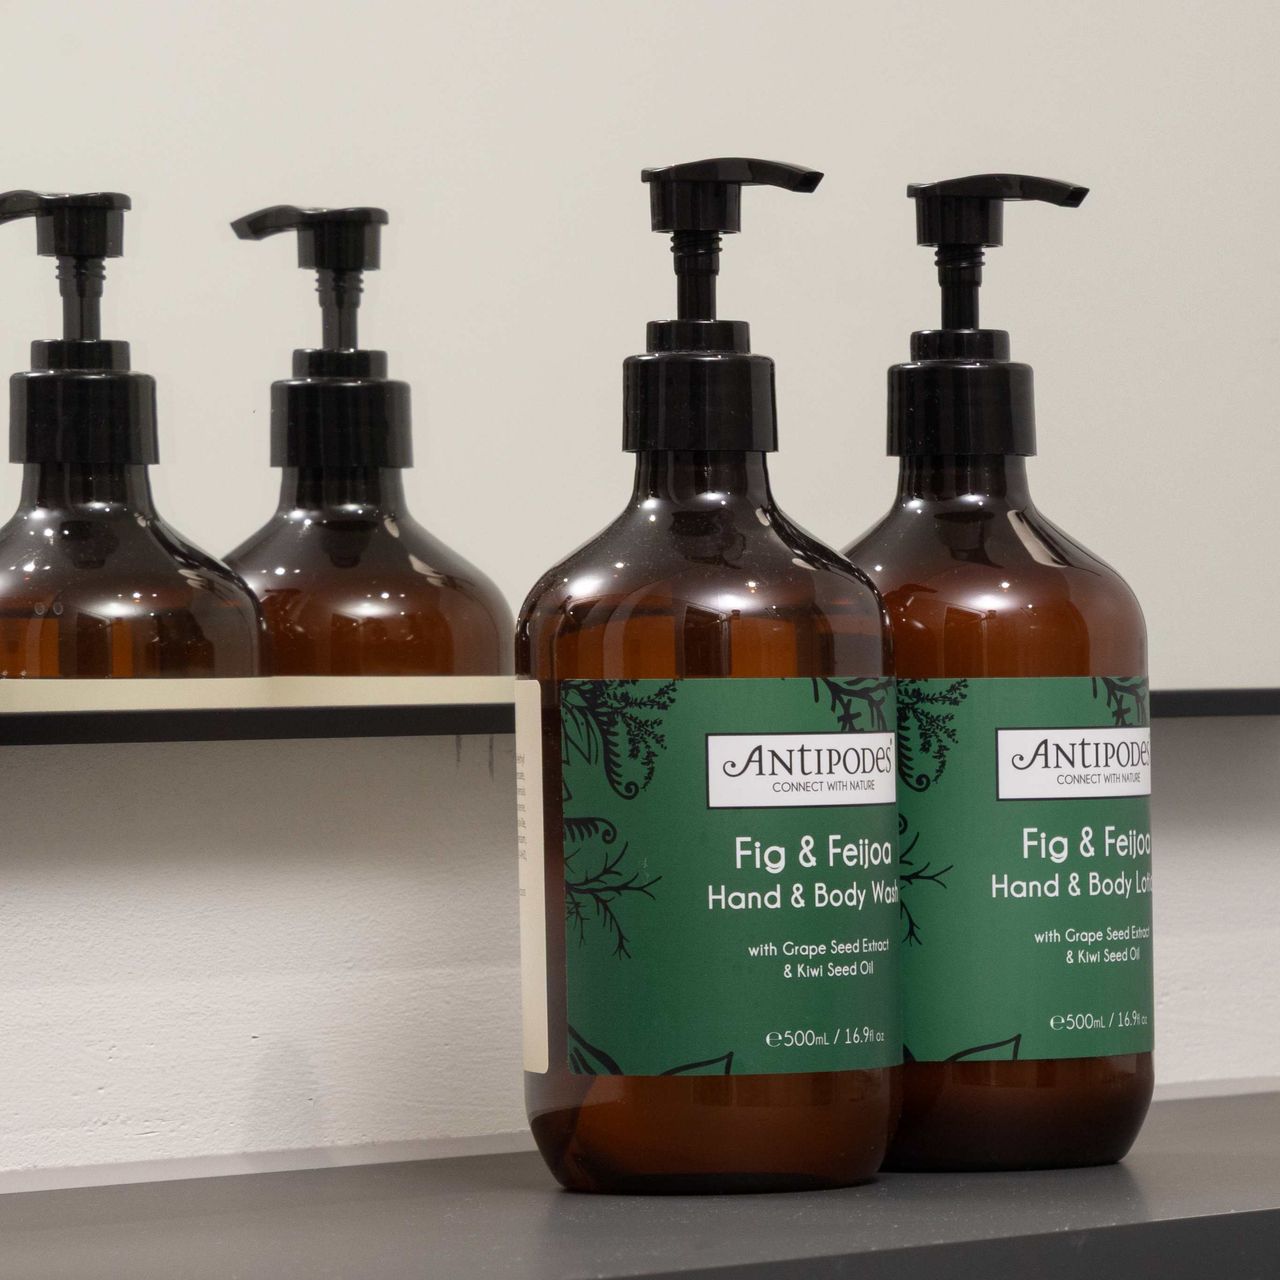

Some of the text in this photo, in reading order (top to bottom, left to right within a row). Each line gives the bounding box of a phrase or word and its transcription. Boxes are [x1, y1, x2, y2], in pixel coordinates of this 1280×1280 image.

[772, 780, 875, 792] CONNECT WITH NATURE
[1057, 774, 1101, 785] CONNECT
[1103, 773, 1121, 784] WITH
[1023, 827, 1068, 863] Fig
[1080, 826, 1095, 857] &
[735, 835, 892, 874] Fig & Feijoa
[992, 873, 1059, 898] Hand
[1068, 872, 1081, 896] &
[1089, 871, 1132, 899] Body
[708, 880, 899, 910] Hand & Body Wash
[1035, 929, 1061, 943] with
[1065, 928, 1103, 945] Grape
[1106, 926, 1130, 941] Seed
[748, 938, 890, 959] with Grape Seed Extract
[1066, 950, 1074, 964] &
[1078, 949, 1101, 963] Kiwi
[1104, 948, 1128, 963] Seed
[784, 961, 874, 978] & Kiwi Seed Oil
[1108, 1011, 1115, 1028] /
[833, 1028, 841, 1045] /
